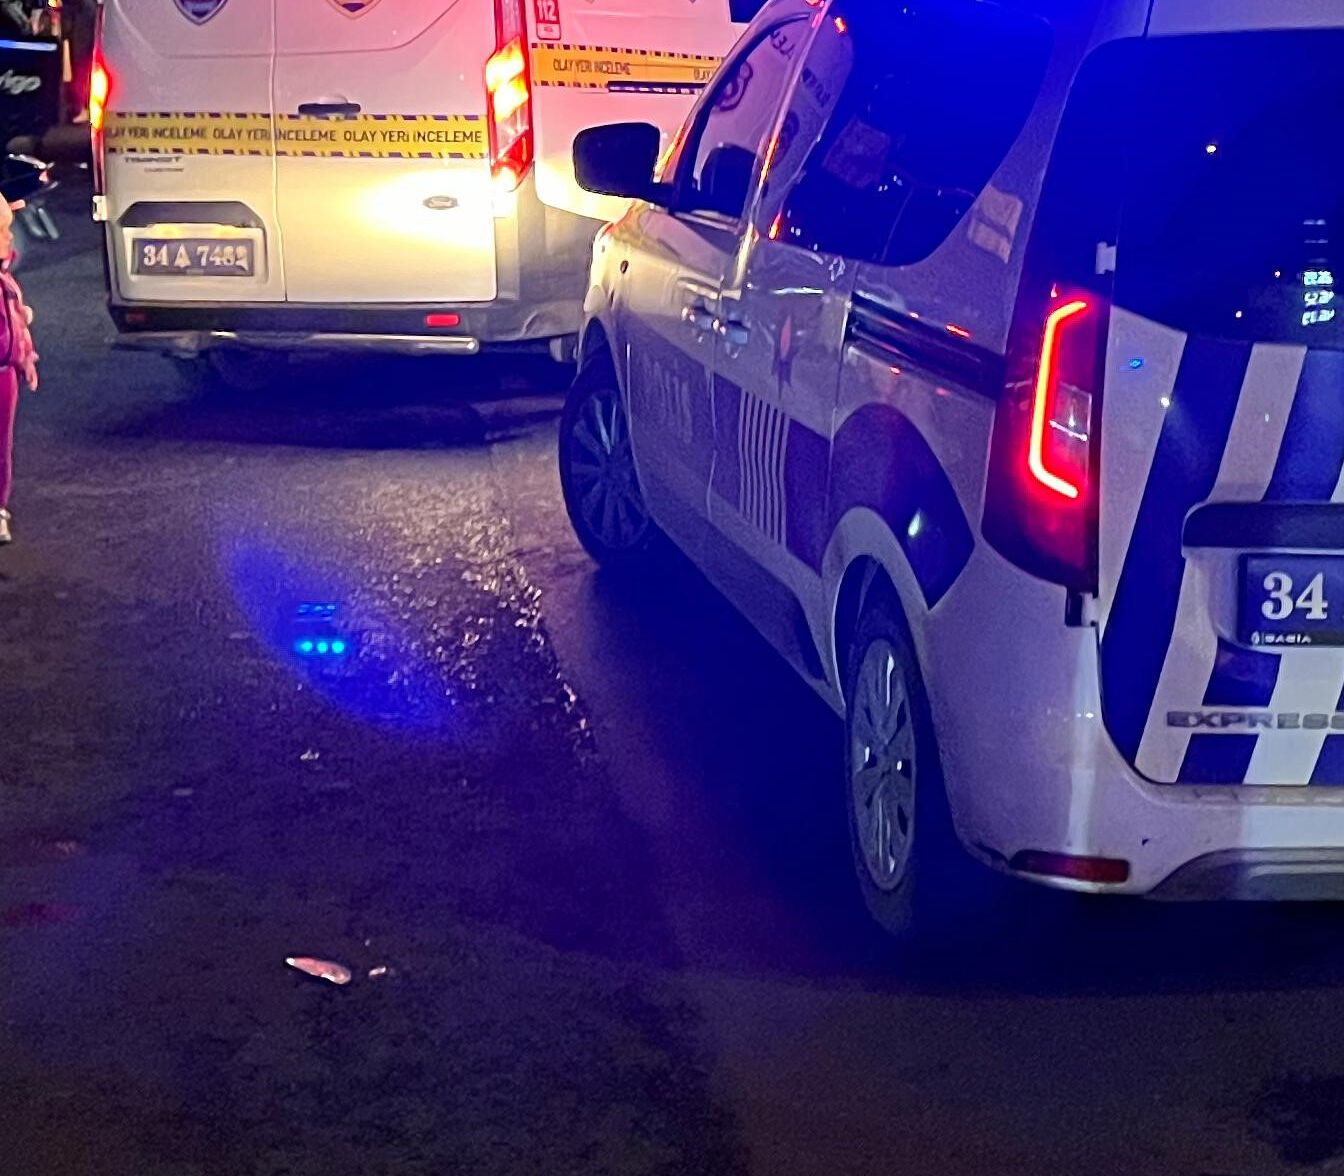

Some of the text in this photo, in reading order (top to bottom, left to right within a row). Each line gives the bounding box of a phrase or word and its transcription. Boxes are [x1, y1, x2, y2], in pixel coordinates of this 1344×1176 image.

[213, 127, 243, 141] OLAY
[343, 129, 377, 143] OLAY
[143, 244, 168, 267] 34
[1261, 571, 1329, 621] 34
